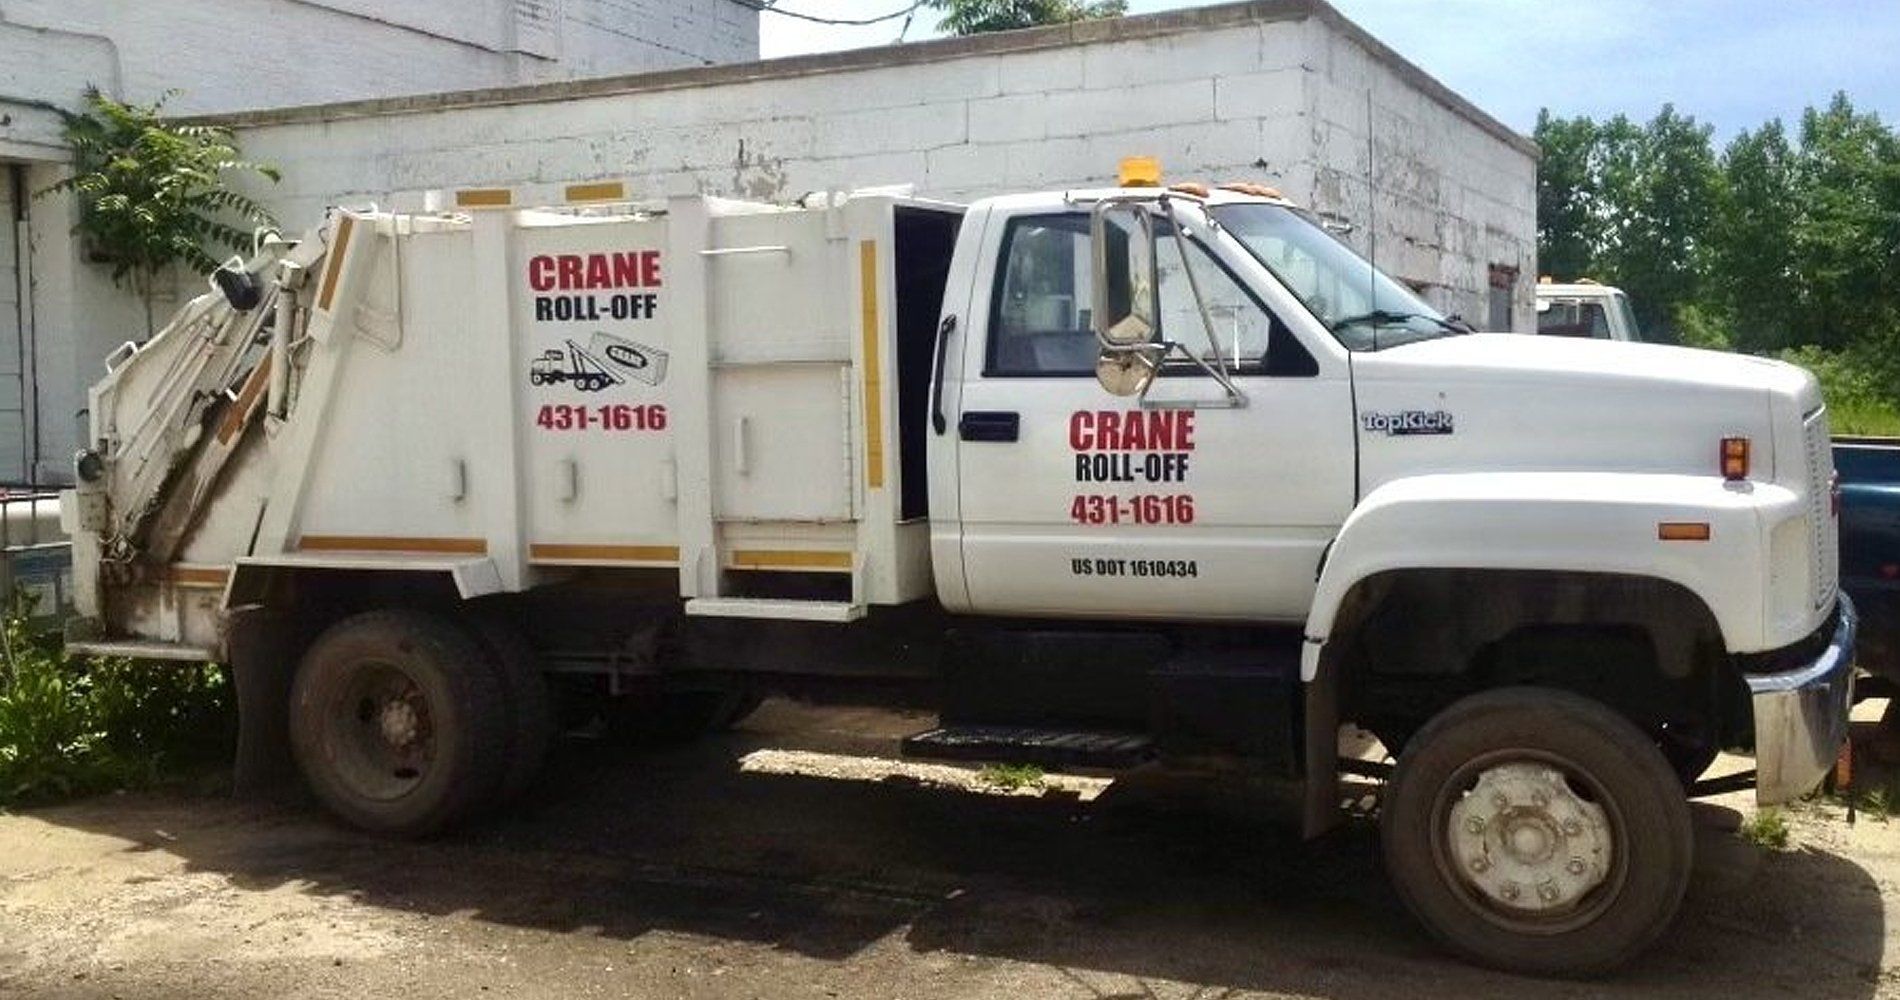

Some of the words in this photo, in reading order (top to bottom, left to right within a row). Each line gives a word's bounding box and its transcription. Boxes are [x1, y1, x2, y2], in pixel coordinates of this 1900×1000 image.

[529, 251, 662, 291] CRANE
[536, 294, 657, 321] ROLL-OFF
[537, 404, 666, 430] 431-1616
[1069, 410, 1195, 451] CRANE
[1362, 411, 1453, 436] TopKick
[1075, 454, 1189, 482] ROLL-OFF
[1071, 495, 1194, 524] 431-1616
[1071, 558, 1092, 575] US
[1096, 559, 1126, 576] DOT
[1130, 560, 1198, 577] 1610434
